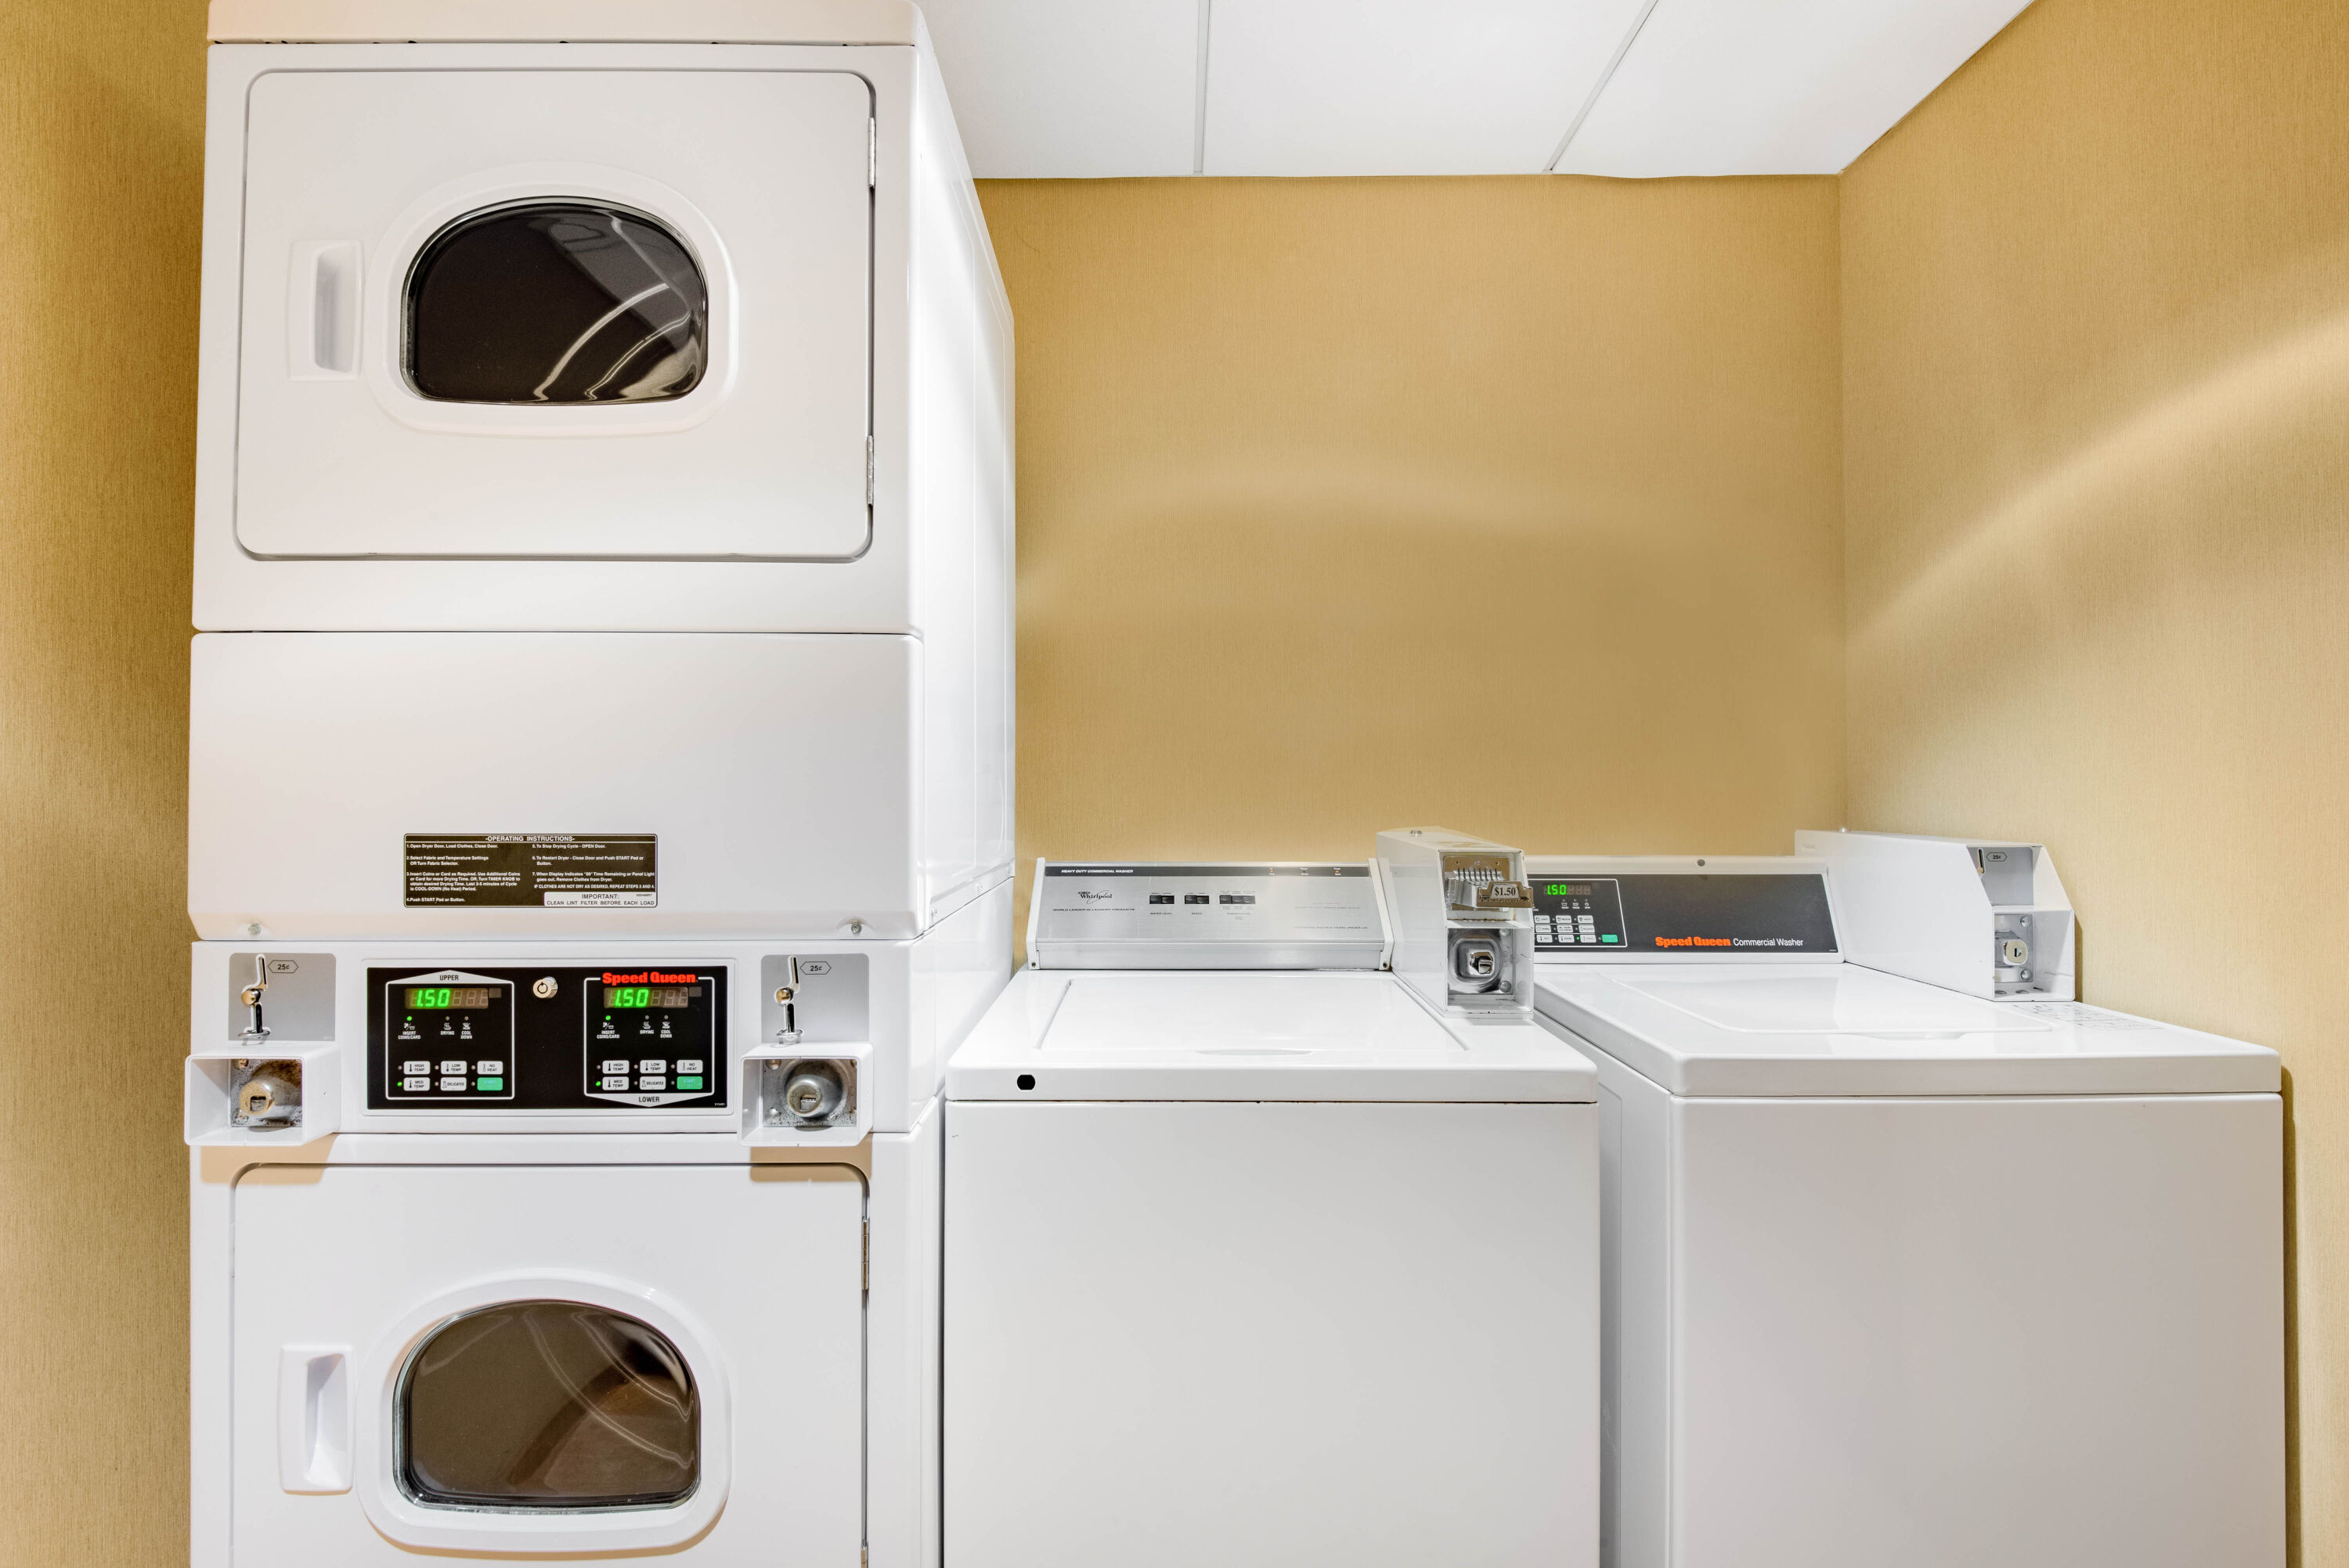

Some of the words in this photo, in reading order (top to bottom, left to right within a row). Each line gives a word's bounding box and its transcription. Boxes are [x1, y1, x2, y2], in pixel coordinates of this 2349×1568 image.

[1495, 887, 1515, 896] $1.50
[1655, 937, 1692, 947] Speed
[1694, 936, 1731, 946] Queen
[603, 972, 648, 986] Speed
[650, 971, 695, 982] Queen
